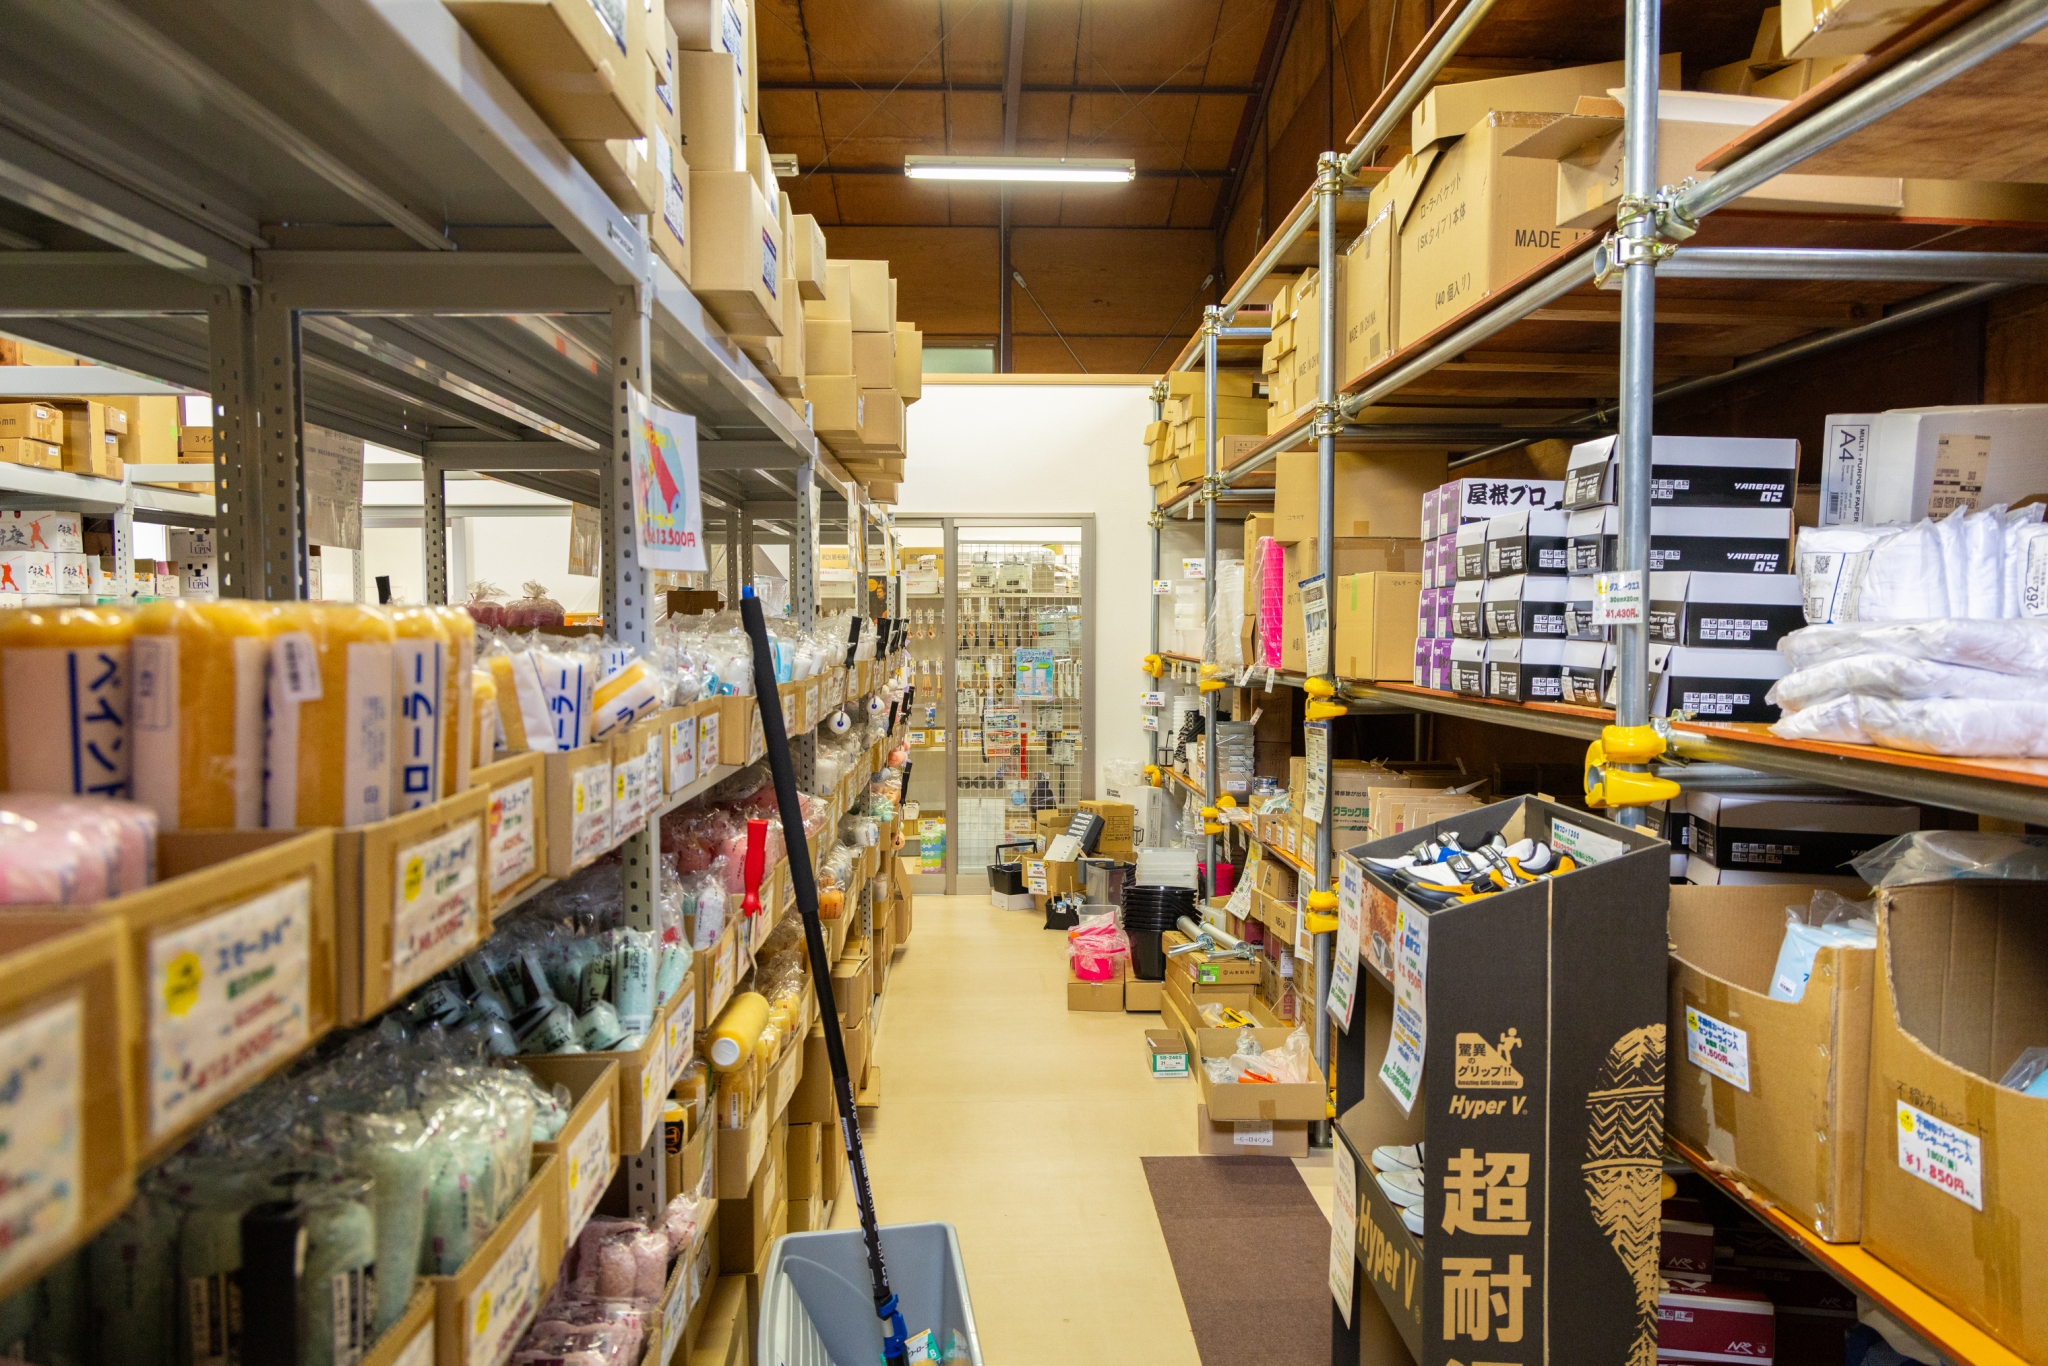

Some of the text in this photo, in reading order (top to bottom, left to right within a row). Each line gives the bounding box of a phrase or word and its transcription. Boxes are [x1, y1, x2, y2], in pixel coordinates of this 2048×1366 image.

[1515, 229, 1561, 248] MADE
[1839, 429, 1856, 462] A4
[1855, 457, 1863, 494] PURPOSE
[1467, 483, 1547, 507] 屋根プロ
[1853, 496, 1861, 523] PAPER
[190, 542, 212, 554] LUPIN
[188, 578, 209, 589] LUPIN
[1609, 582, 1640, 592] ダスーウエス
[1458, 1044, 1486, 1056] 驚異
[1458, 1065, 1512, 1077] グリップ!!
[1448, 1095, 1527, 1119] Hyper V
[1358, 1193, 1417, 1311] Hyper V
[1441, 1149, 1532, 1366] 超耐
[929, 1349, 937, 1359] B
